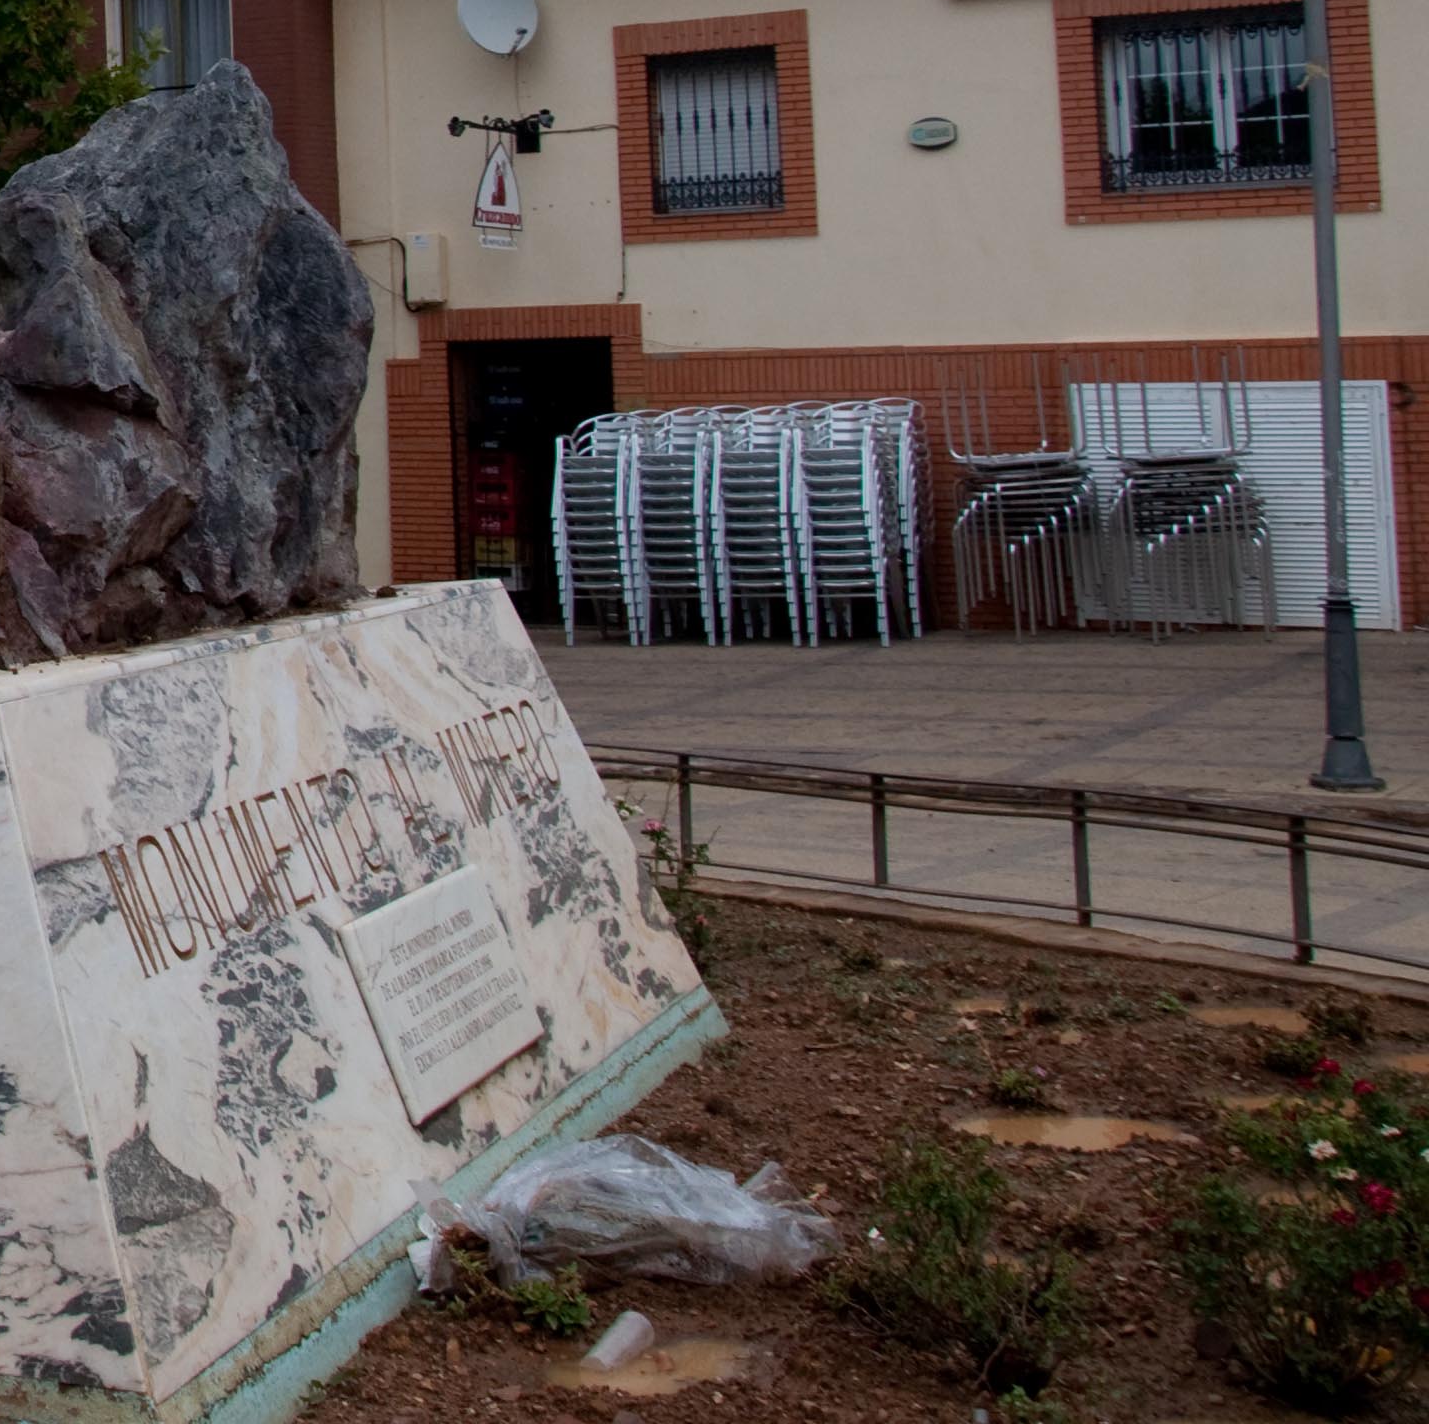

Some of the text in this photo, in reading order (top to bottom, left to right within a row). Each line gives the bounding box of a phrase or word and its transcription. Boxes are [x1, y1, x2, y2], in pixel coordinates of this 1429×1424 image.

[97, 699, 561, 978] MONUMENTO AL MINERO
